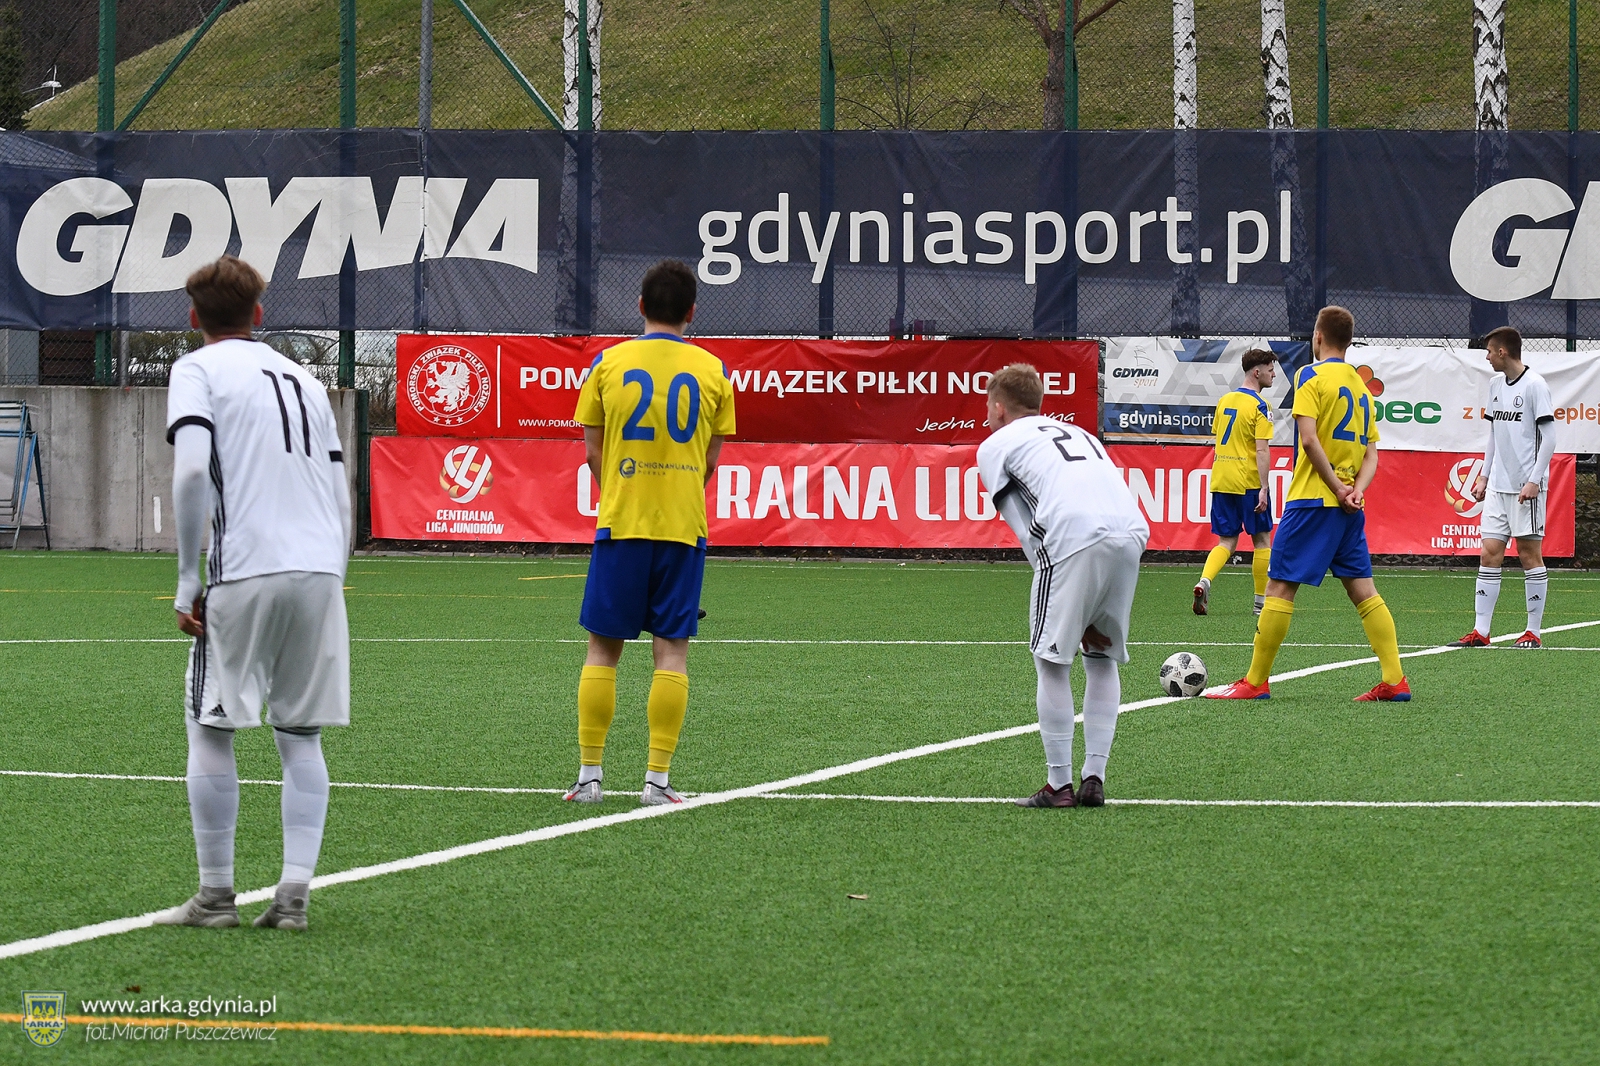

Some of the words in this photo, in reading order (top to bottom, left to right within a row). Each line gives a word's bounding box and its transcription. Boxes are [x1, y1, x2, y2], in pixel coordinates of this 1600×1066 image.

[16, 176, 539, 296] GDYNIA
[698, 190, 1292, 285] gdyniasport.pl
[730, 369, 848, 398] WIĄZEK
[857, 371, 937, 394] PIŁKI
[947, 366, 1076, 395] NOEJ
[1112, 367, 1159, 378] GDYNIA
[409, 365, 425, 412] POMORSKI
[1133, 377, 1158, 388] sport
[261, 369, 311, 458] 11
[622, 368, 700, 444] 20
[518, 418, 585, 428] WWW.POMOR
[916, 416, 976, 432] Jedna
[1119, 410, 1215, 429] gdyniasport
[1332, 386, 1370, 447] 21
[1221, 408, 1238, 446] 7
[637, 461, 699, 473] CHIGNAHUAPAN
[577, 463, 899, 521] CRALNA
[915, 466, 1005, 521] LIG
[436, 509, 495, 522] CENTRALNA
[425, 521, 448, 533] LIGA
[449, 520, 505, 534] JUNIORÓW
[1442, 524, 1482, 536] CENTRA
[1431, 537, 1454, 549] LIGA
